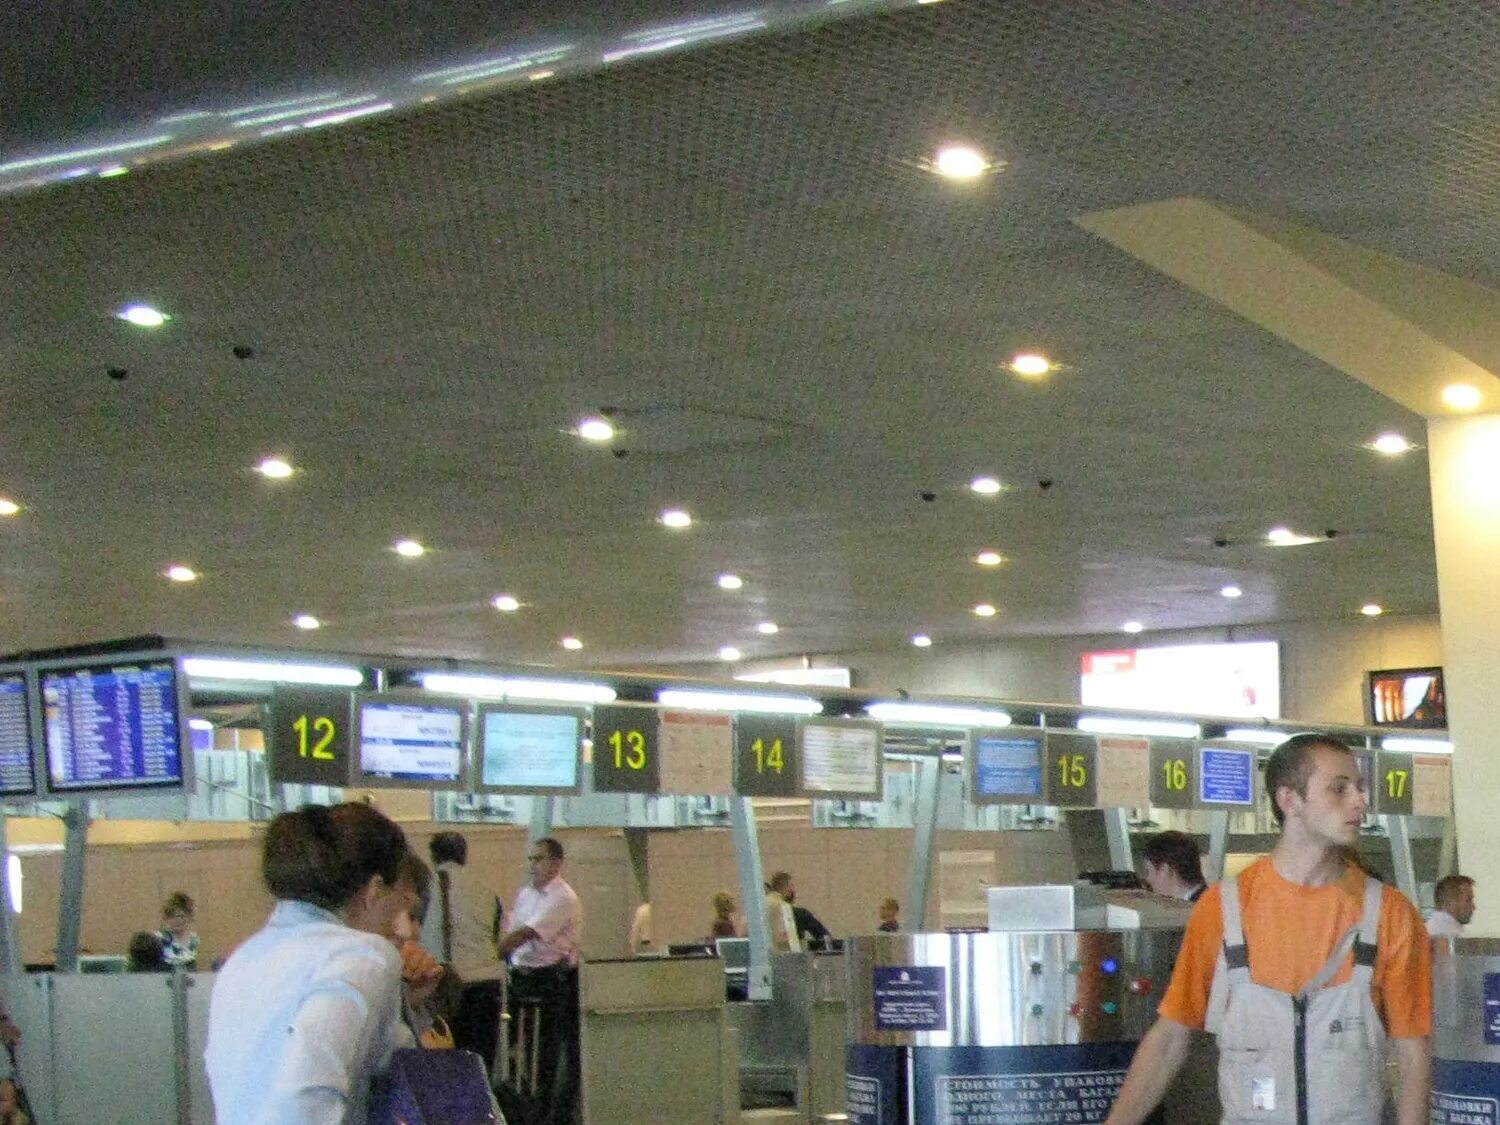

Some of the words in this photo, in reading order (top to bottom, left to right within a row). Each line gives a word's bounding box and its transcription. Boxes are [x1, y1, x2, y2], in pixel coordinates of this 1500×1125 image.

[293, 715, 336, 761] 12
[608, 730, 647, 771] 13
[751, 739, 784, 775] 14
[1058, 755, 1089, 788] 15
[1163, 759, 1187, 791] 16
[1386, 770, 1409, 799] 17
